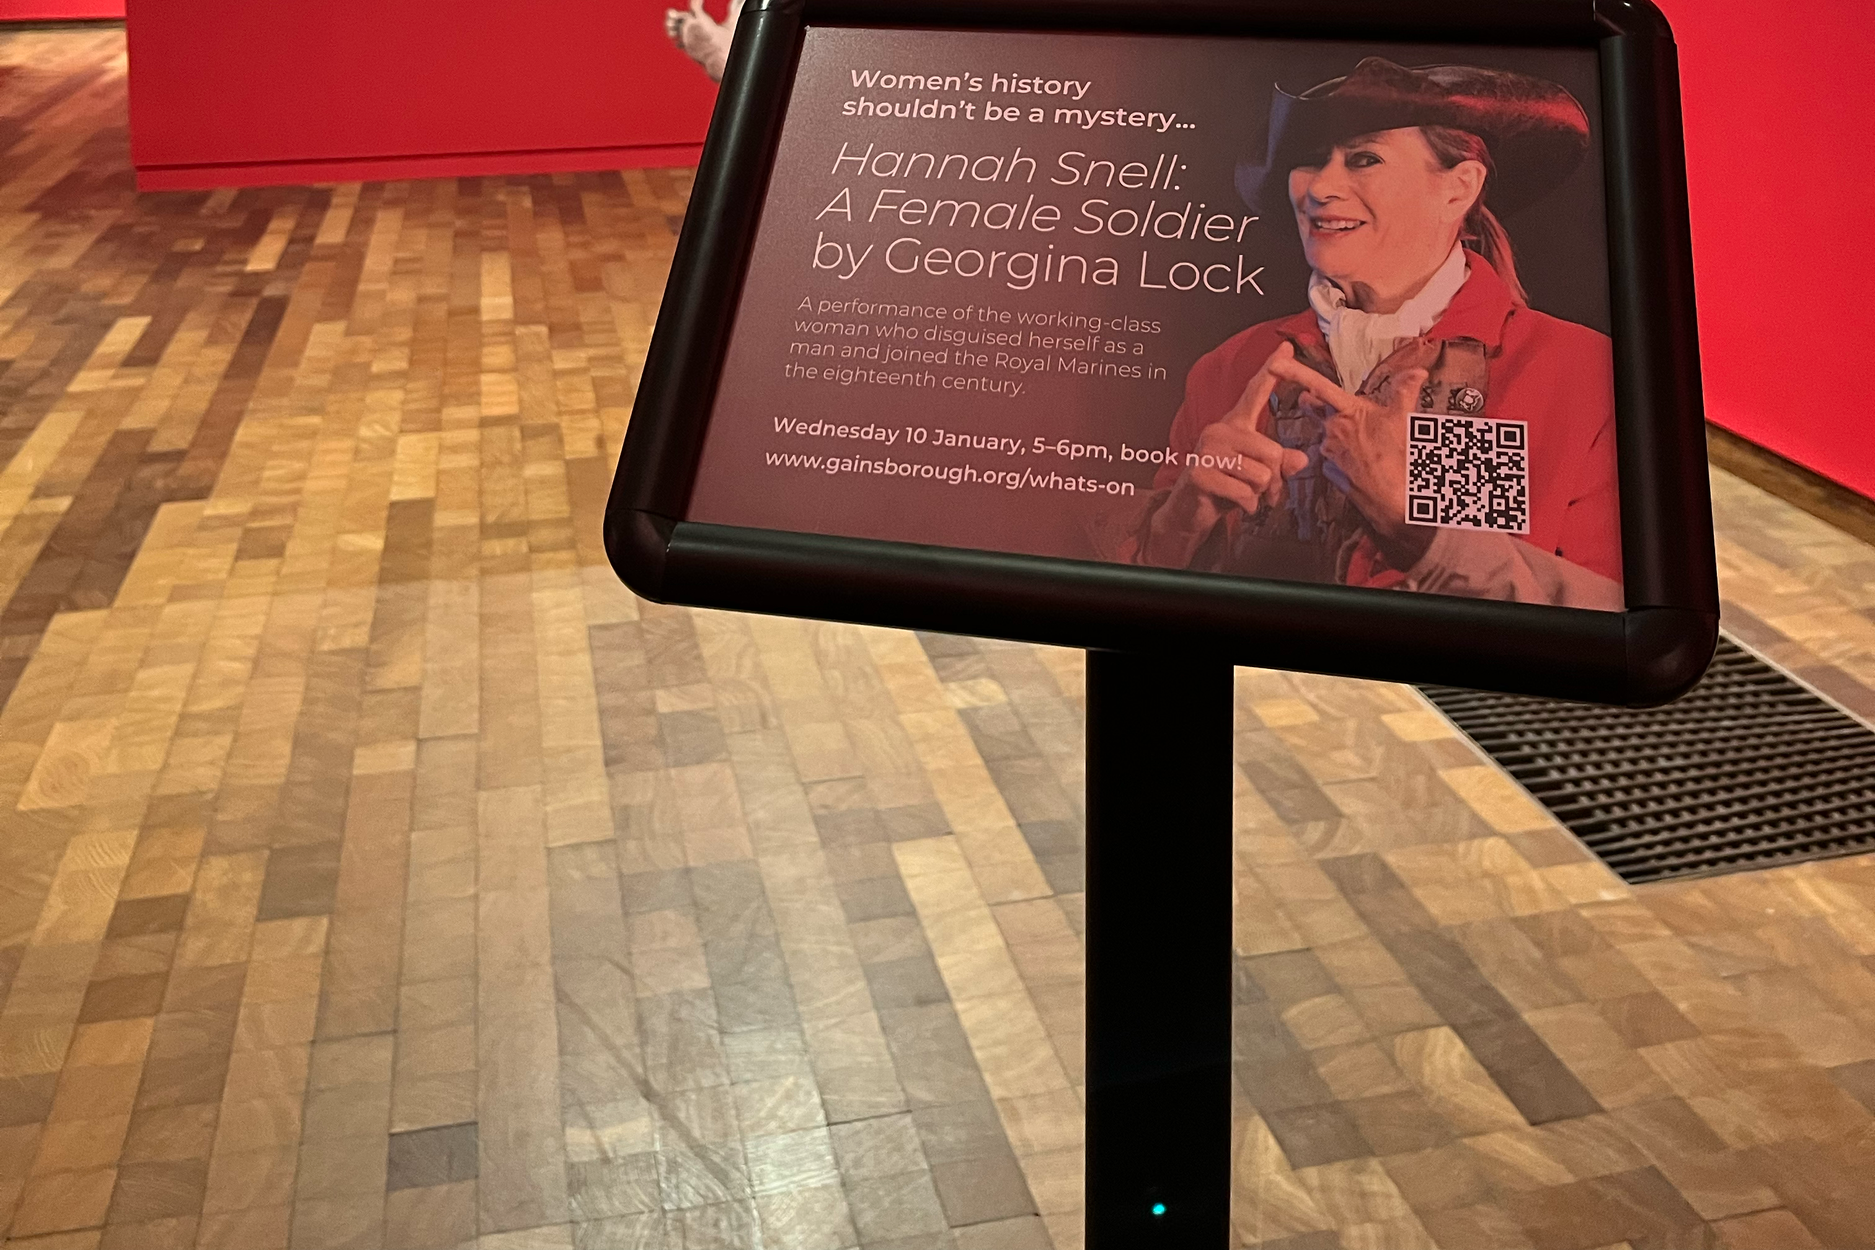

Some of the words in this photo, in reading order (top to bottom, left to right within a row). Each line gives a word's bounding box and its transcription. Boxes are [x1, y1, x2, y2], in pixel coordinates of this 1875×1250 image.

[851, 69, 983, 92] Women’s
[991, 72, 1092, 101] history
[841, 96, 977, 121] shouldn’t
[984, 100, 1021, 122] be
[1028, 107, 1045, 123] a
[1053, 108, 1196, 133] mystery...
[831, 141, 1037, 184] Hannah
[1050, 151, 1188, 191] Snell:
[814, 187, 852, 222] A
[868, 188, 1061, 232] Female
[1072, 198, 1260, 243] Soldier
[812, 231, 874, 280] by
[885, 237, 1119, 291] Georgina
[1139, 250, 1265, 296] Lock
[797, 295, 813, 312] A
[817, 297, 948, 320] performance
[952, 304, 974, 321] of
[978, 306, 1012, 324] the
[1017, 310, 1161, 334] working-class
[794, 320, 870, 337] woman
[875, 322, 919, 340] who
[923, 324, 1023, 348] disguised
[1028, 330, 1101, 354] herself
[1104, 340, 1127, 354] as
[1132, 342, 1144, 356] a
[785, 362, 818, 379] the
[823, 364, 936, 388] eighteenth
[941, 376, 1026, 398] century.
[789, 342, 835, 357] man
[840, 343, 881, 360] and
[882, 343, 949, 365] joined
[954, 349, 989, 367] the
[995, 352, 1051, 374] Royal
[1057, 356, 1142, 378] Marines
[1148, 362, 1167, 381] in
[773, 416, 900, 446] Wednesday
[905, 426, 928, 444] 10
[931, 428, 1026, 456] January,
[1120, 443, 1179, 466] book
[1185, 453, 1243, 472] now!
[765, 451, 1135, 499] www.gainsborough.org/whats-on
